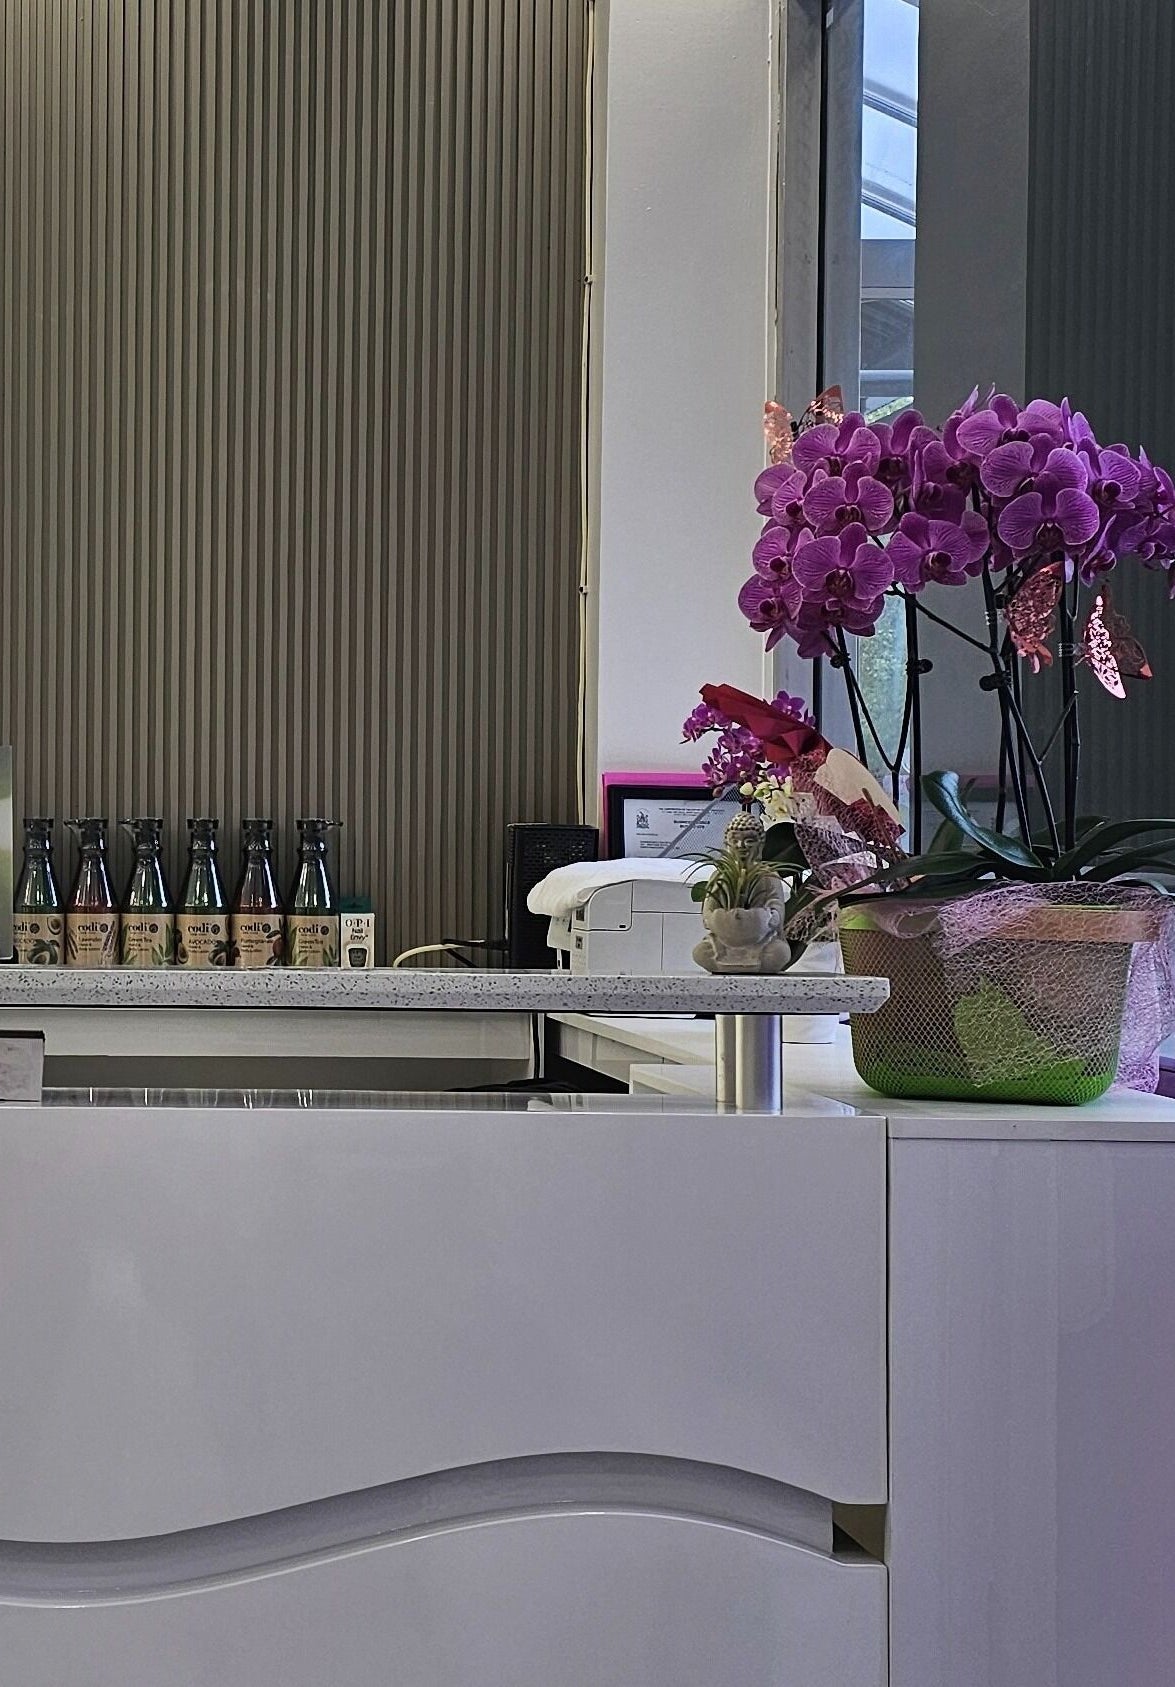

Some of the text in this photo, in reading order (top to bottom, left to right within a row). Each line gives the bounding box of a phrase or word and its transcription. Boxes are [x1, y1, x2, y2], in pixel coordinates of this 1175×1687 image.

[78, 922, 98, 931] codi
[128, 922, 148, 931] codi
[187, 923, 209, 932] codi
[240, 922, 261, 931] codi
[299, 924, 319, 933] codi
